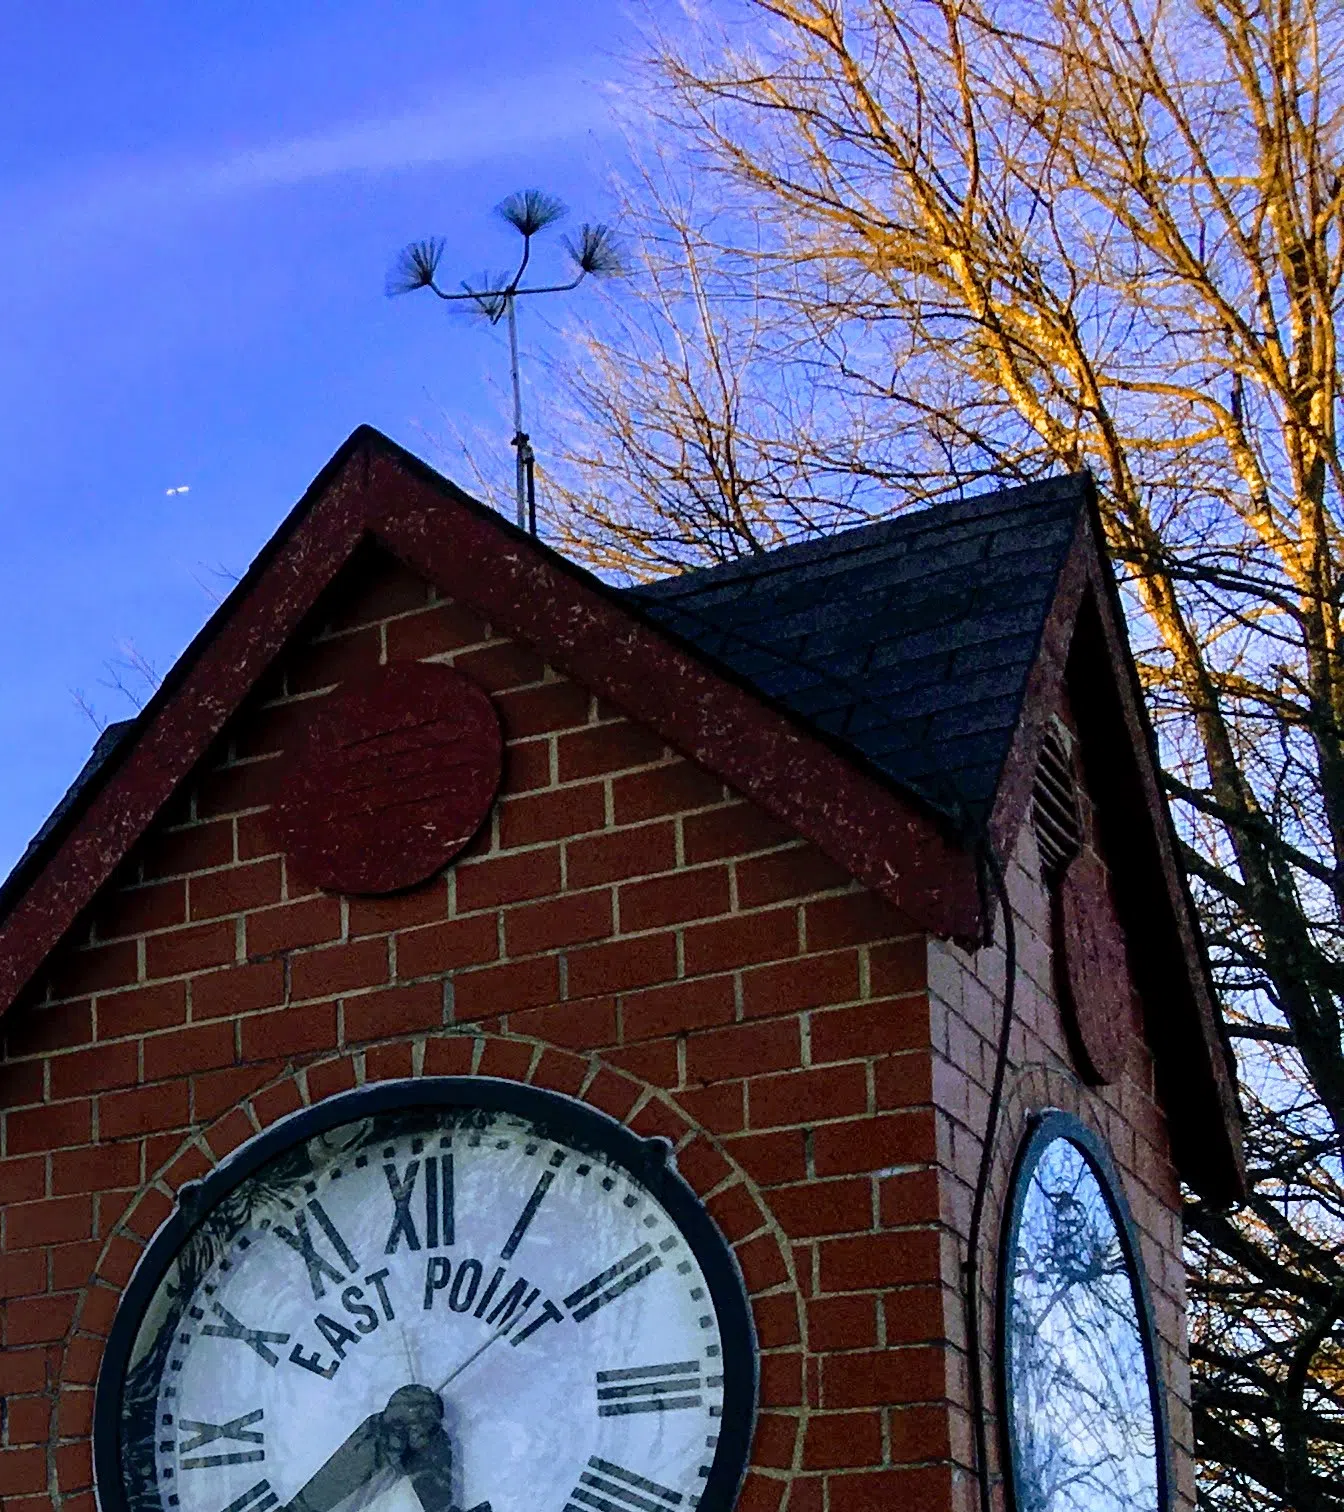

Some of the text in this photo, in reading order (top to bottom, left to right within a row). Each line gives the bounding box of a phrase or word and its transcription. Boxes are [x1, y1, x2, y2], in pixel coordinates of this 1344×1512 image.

[383, 1153, 456, 1255] XII
[272, 1198, 360, 1301] XI
[564, 1241, 664, 1323] II
[201, 1300, 291, 1368] X
[288, 1256, 565, 1380] EAST POINT
[596, 1360, 703, 1418] III
[178, 1408, 266, 1471] IX
